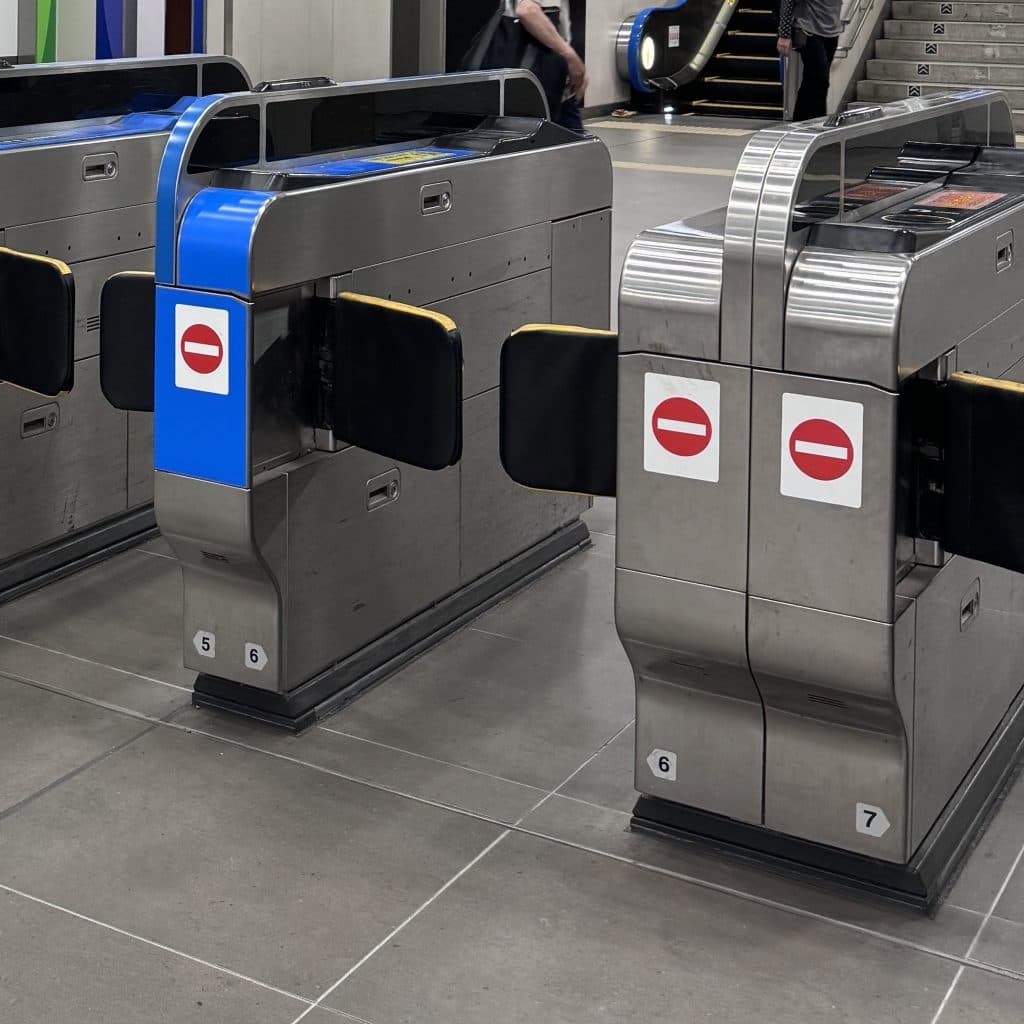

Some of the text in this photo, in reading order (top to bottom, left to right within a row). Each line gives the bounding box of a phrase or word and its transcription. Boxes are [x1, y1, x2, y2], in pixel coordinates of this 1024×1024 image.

[201, 636, 211, 653] 5
[249, 647, 259, 664] 6
[658, 756, 670, 773] 6
[863, 810, 877, 828] 7
